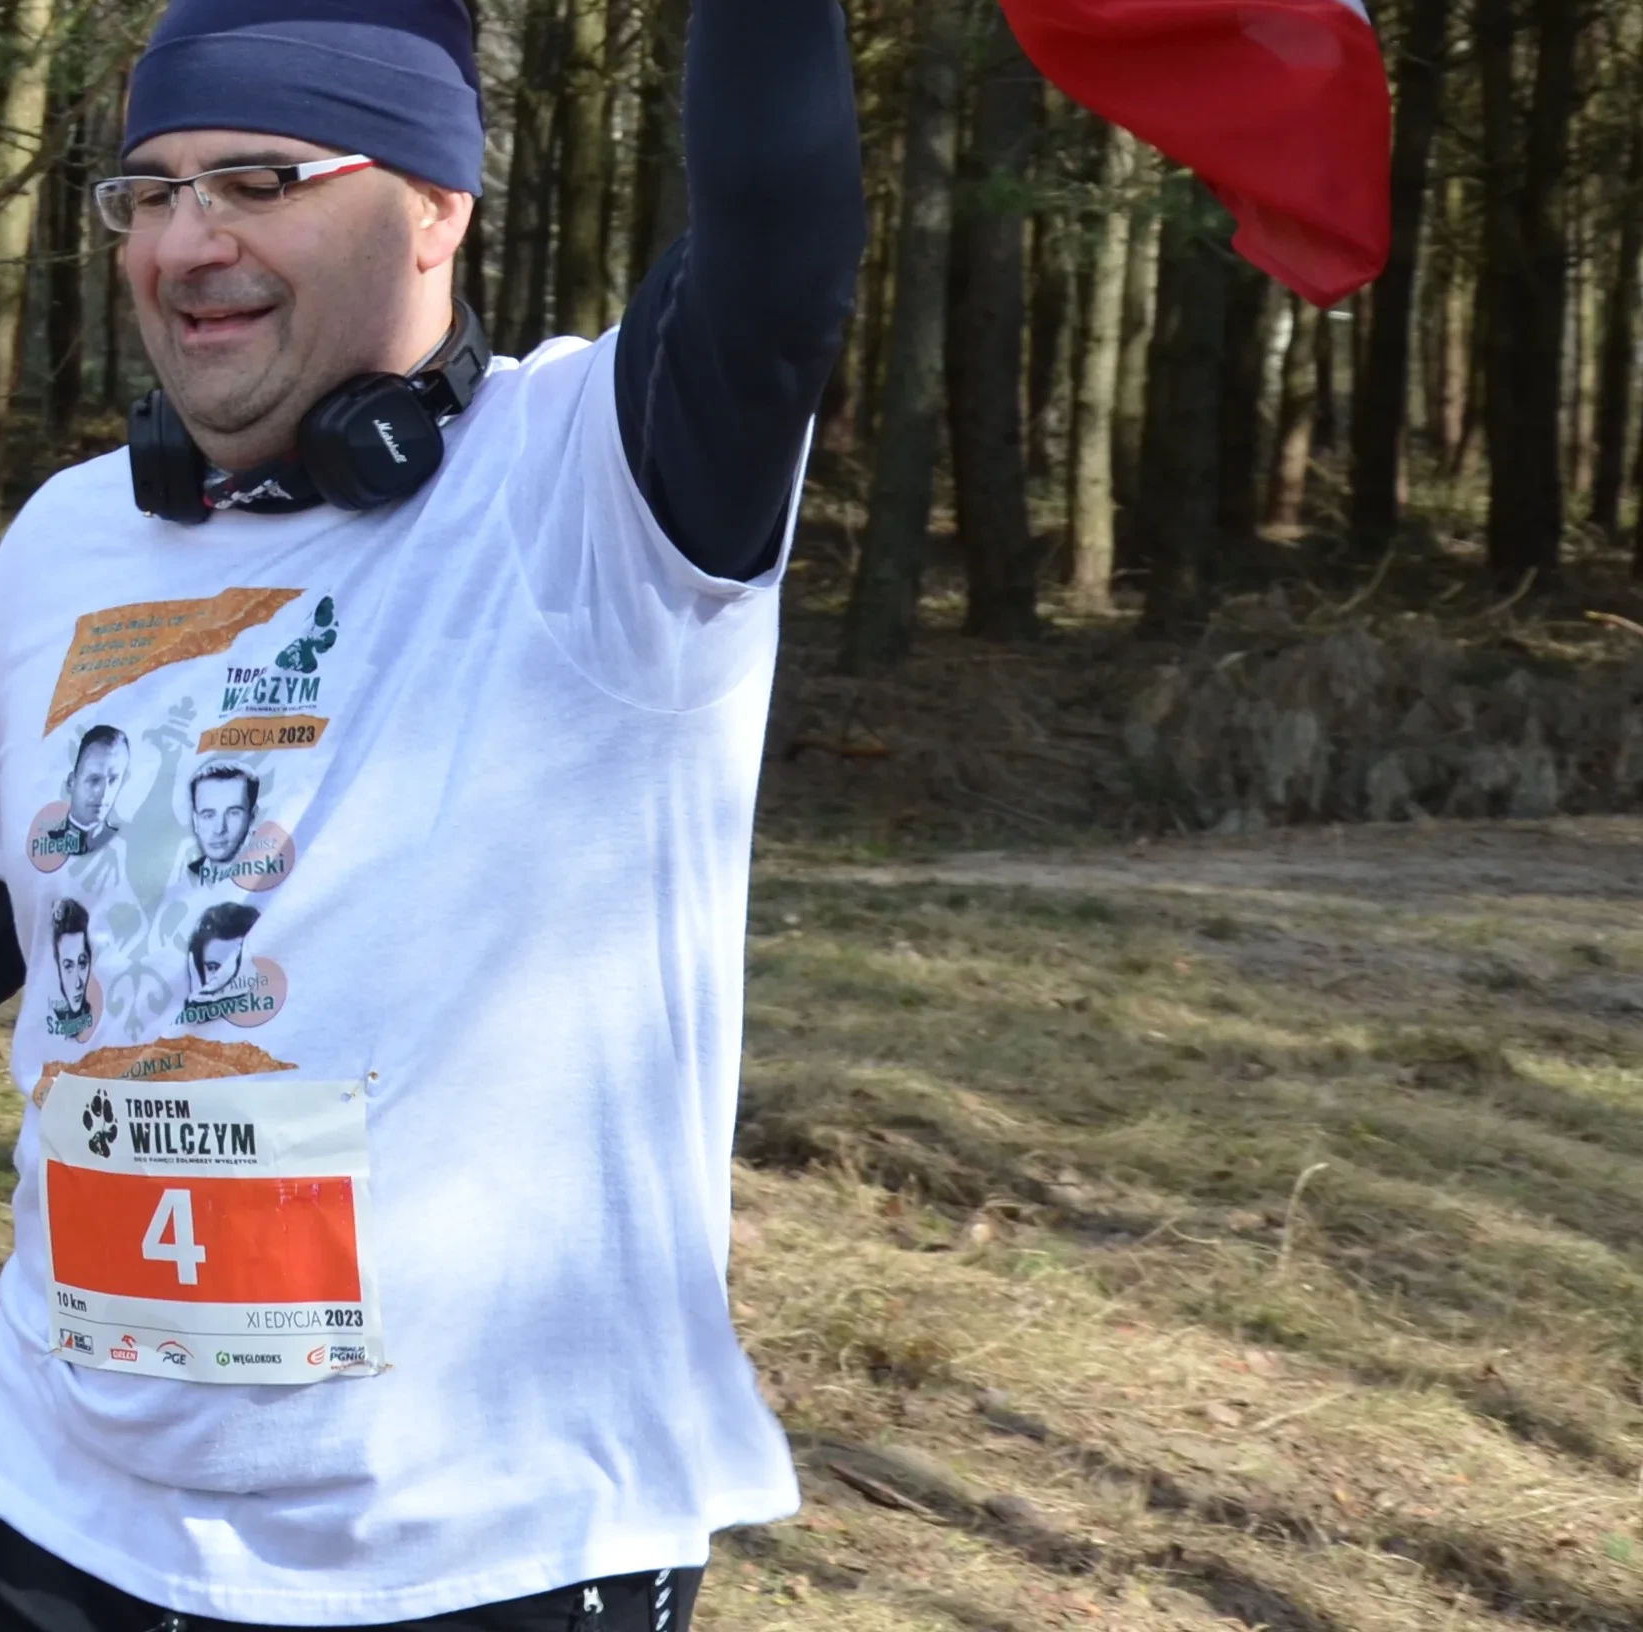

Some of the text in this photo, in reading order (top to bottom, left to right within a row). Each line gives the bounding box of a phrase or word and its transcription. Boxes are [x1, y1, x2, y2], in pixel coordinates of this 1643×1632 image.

[372, 419, 408, 464] Marshall
[278, 725, 316, 744] 2023
[125, 1098, 190, 1119] TROPEM
[128, 1121, 257, 1156] WILCZYM
[141, 1187, 207, 1286] 4
[57, 1290, 88, 1313] 10 km
[246, 1309, 365, 1329] XI EDYCJA 2023
[112, 1350, 137, 1361] ORLEN
[162, 1351, 187, 1366] PGE
